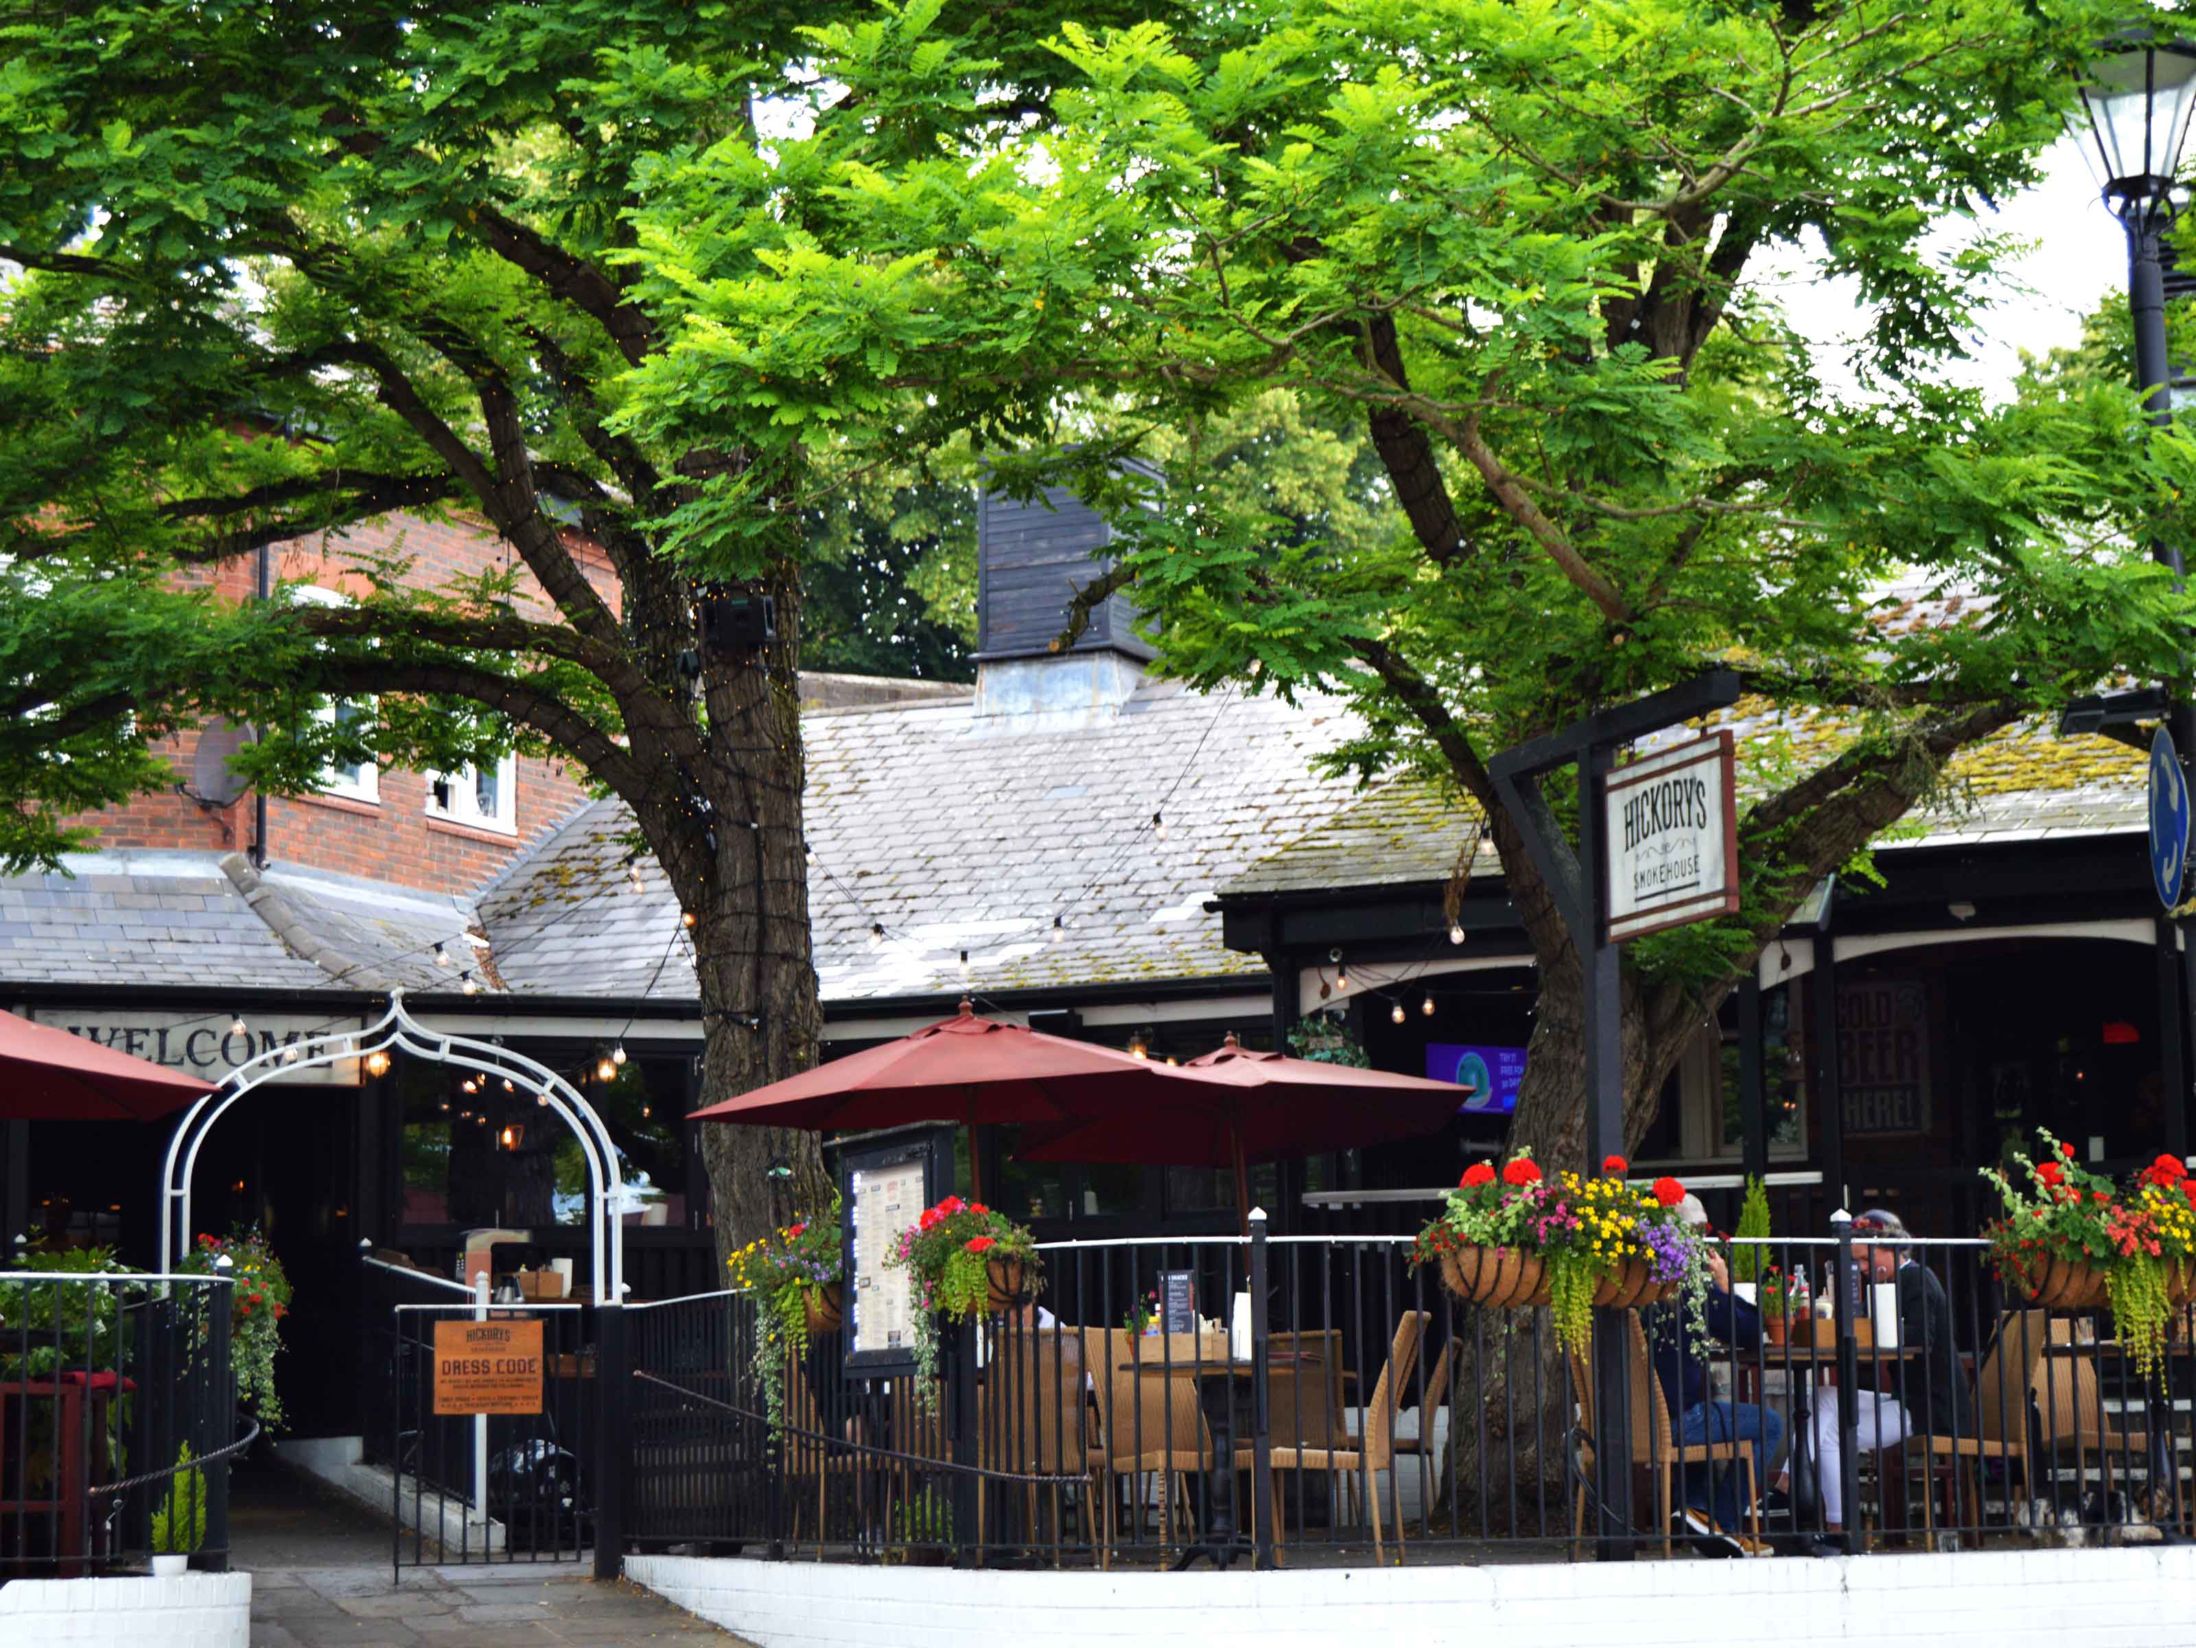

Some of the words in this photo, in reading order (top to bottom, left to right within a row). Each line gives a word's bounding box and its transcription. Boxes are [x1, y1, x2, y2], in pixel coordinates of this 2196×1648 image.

[1624, 778, 1707, 852] HICKORY'S
[1634, 855, 1700, 890] SMOKEHOUSE
[1843, 1089, 1915, 1131] HERE!
[442, 1360, 490, 1375] DRESS
[496, 1359, 536, 1374] CODE
